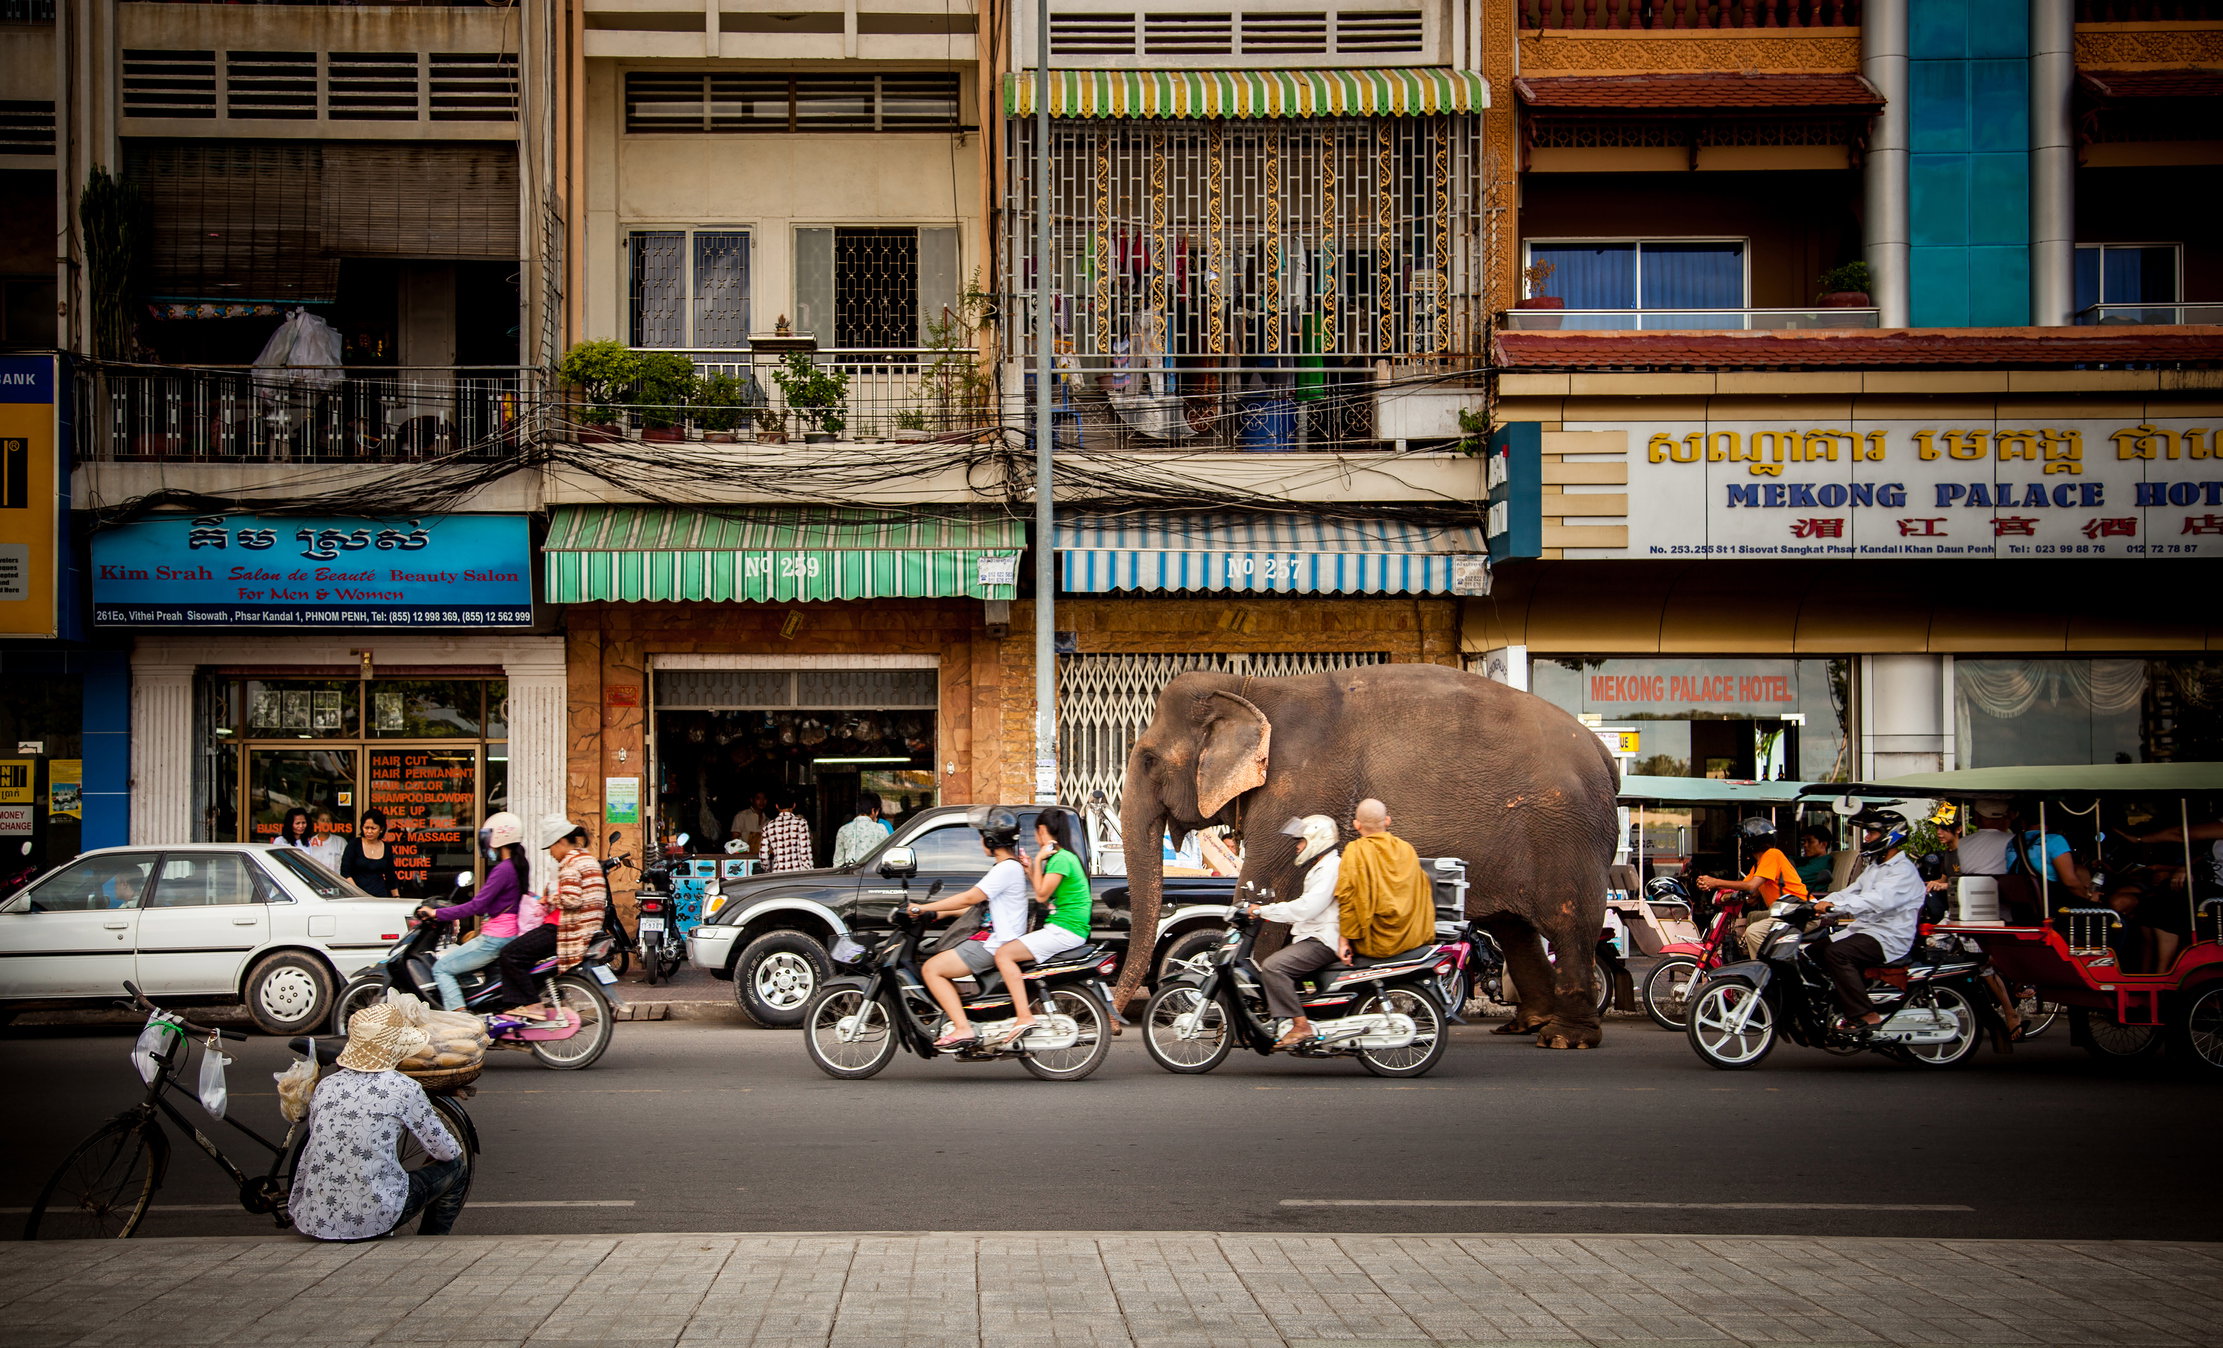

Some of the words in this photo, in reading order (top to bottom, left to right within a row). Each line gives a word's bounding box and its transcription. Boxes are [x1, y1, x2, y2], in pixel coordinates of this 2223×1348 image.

[0, 374, 36, 385] ANK
[1727, 483, 1908, 508] MEKONG
[1935, 482, 2105, 508] PALACE
[2135, 481, 2223, 507] HOT
[1650, 545, 1667, 554] No.
[1671, 545, 1714, 554] 253.255
[1716, 545, 1728, 554] St
[1730, 545, 1736, 554] 1
[1738, 545, 1779, 554] Sisovat
[1780, 545, 1825, 556] Sangkat
[1827, 545, 1858, 554] Phsar
[1860, 544, 1898, 554] Kandal
[1904, 545, 1933, 554] Khan
[1936, 545, 1964, 554] Daun
[1967, 545, 1994, 554] Penh
[2008, 544, 2031, 554] Tel:
[2035, 544, 2056, 554] 023
[2060, 544, 2074, 554] 99
[2076, 544, 2090, 554] 88
[2092, 544, 2106, 554] 76
[2126, 544, 2145, 554] 012
[2150, 544, 2165, 554] 72
[2167, 544, 2181, 554] 78
[2183, 544, 2199, 554] 87
[781, 557, 819, 577] 259
[1265, 558, 1303, 579] 257
[100, 566, 149, 580] Kim
[156, 566, 214, 580] Srah
[228, 566, 281, 581] Salon
[288, 569, 308, 581] de
[314, 567, 375, 582] Beauté
[390, 569, 459, 584] Beauty
[463, 569, 519, 582] Salon
[238, 587, 265, 600] For
[271, 587, 309, 600] Men
[315, 588, 329, 600] &
[335, 588, 404, 601] Women
[96, 610, 127, 622] 261Eo,
[129, 610, 155, 621] Vithei
[156, 611, 183, 621] Preah
[234, 611, 261, 621] Phsar
[262, 611, 294, 621] Kandal
[295, 612, 304, 623] 1,
[305, 612, 340, 621] PHNOM
[341, 612, 370, 623] PENH,
[371, 612, 387, 621] Tel:
[388, 611, 411, 623] (855)
[412, 612, 424, 621] 12
[424, 612, 441, 621] 998
[442, 612, 460, 623] 369,
[461, 611, 484, 623] (855)
[485, 612, 496, 621] 12
[497, 612, 514, 621] 562
[515, 612, 530, 621] 999
[1591, 675, 1665, 702] MEKONG
[1670, 675, 1735, 702] PALACE
[1739, 675, 1793, 702] HOTEL
[372, 756, 401, 766] HAIR
[405, 756, 428, 766] CUT
[372, 768, 401, 779] HAIR
[405, 768, 475, 779] PERMANENT
[372, 781, 401, 791] HAIR
[404, 781, 443, 791] COLOR
[371, 793, 423, 803] SHAMPOO
[424, 793, 475, 803] BLOWDRY
[409, 806, 425, 816] UP
[0, 822, 32, 831] CHANGE
[257, 823, 285, 833] BUSI
[313, 823, 353, 833] HOURS
[386, 819, 429, 829] SSAGE
[429, 819, 457, 829] FACE
[407, 832, 461, 842] MASSAGE
[391, 845, 418, 855] XING
[395, 870, 428, 880] CURE
